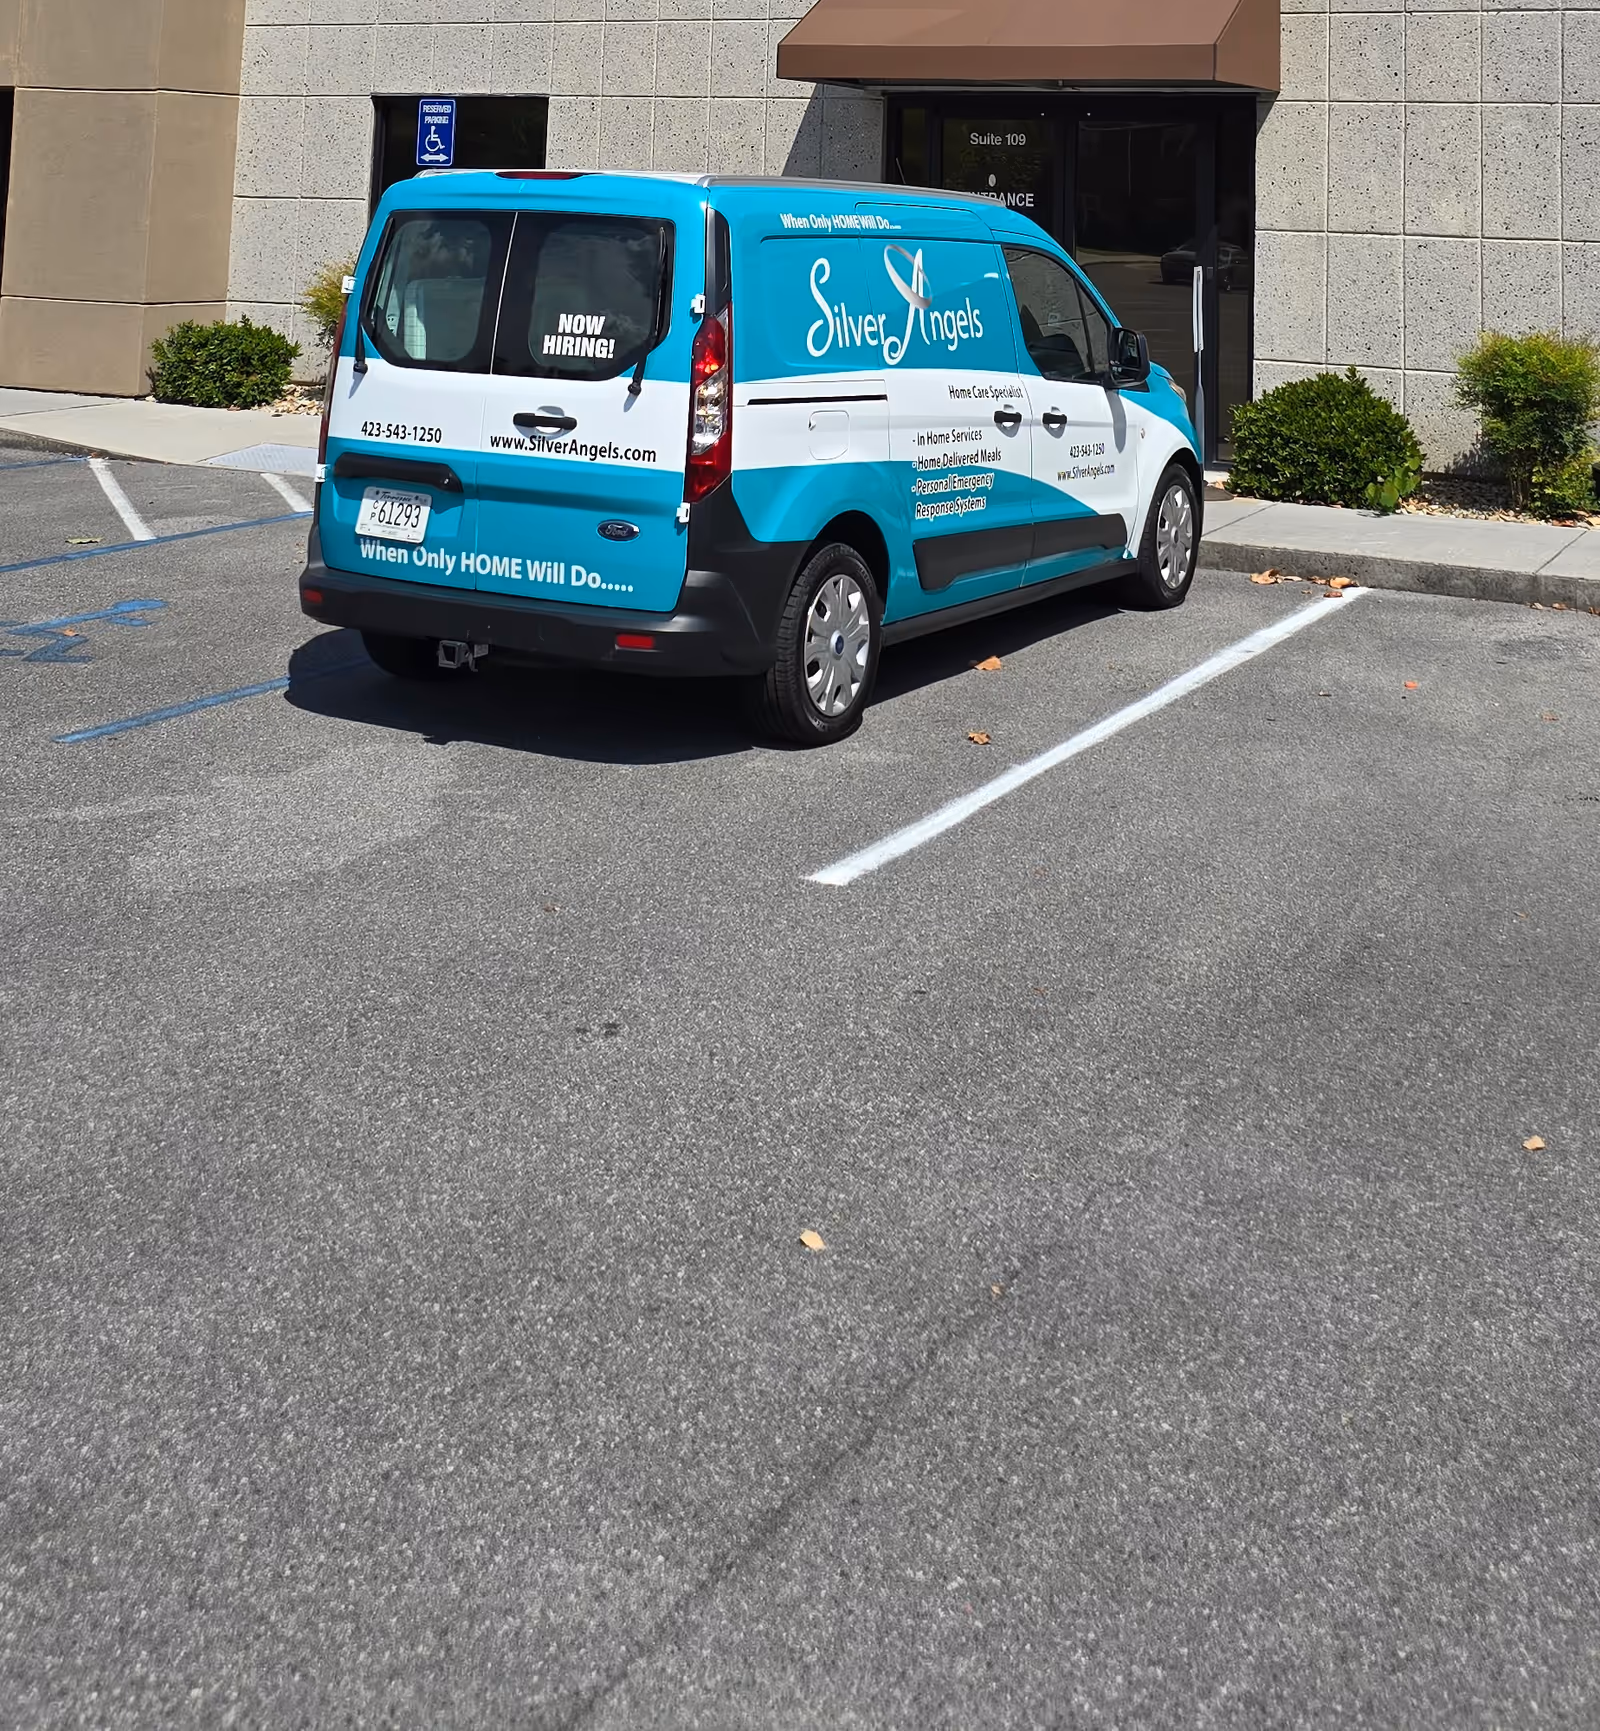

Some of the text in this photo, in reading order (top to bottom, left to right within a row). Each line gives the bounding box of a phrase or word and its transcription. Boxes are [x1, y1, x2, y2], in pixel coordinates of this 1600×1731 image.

[422, 104, 452, 114] RESERVED
[424, 115, 449, 124] PARKING
[969, 132, 1027, 146] Suite 109
[779, 213, 810, 229] When
[809, 213, 831, 233] Only
[831, 214, 860, 229] HOME
[859, 214, 877, 229] Will
[806, 248, 984, 365] Silver Angels
[557, 313, 606, 335] NOW
[542, 334, 616, 359] HIRING!
[948, 385, 1024, 401] Home Care Specialist
[361, 420, 442, 443] 423-543-1250
[917, 427, 983, 446] In Home Services
[490, 435, 657, 462] www.SilverAngels.com
[917, 447, 1002, 470] Home Delivered Meals
[917, 472, 994, 495] Personal Emergency
[378, 500, 421, 528] 61293
[916, 496, 987, 521] Response Systems
[360, 537, 409, 564] When
[413, 545, 457, 576] Only
[460, 551, 523, 579] HOME
[526, 559, 565, 585] Will
